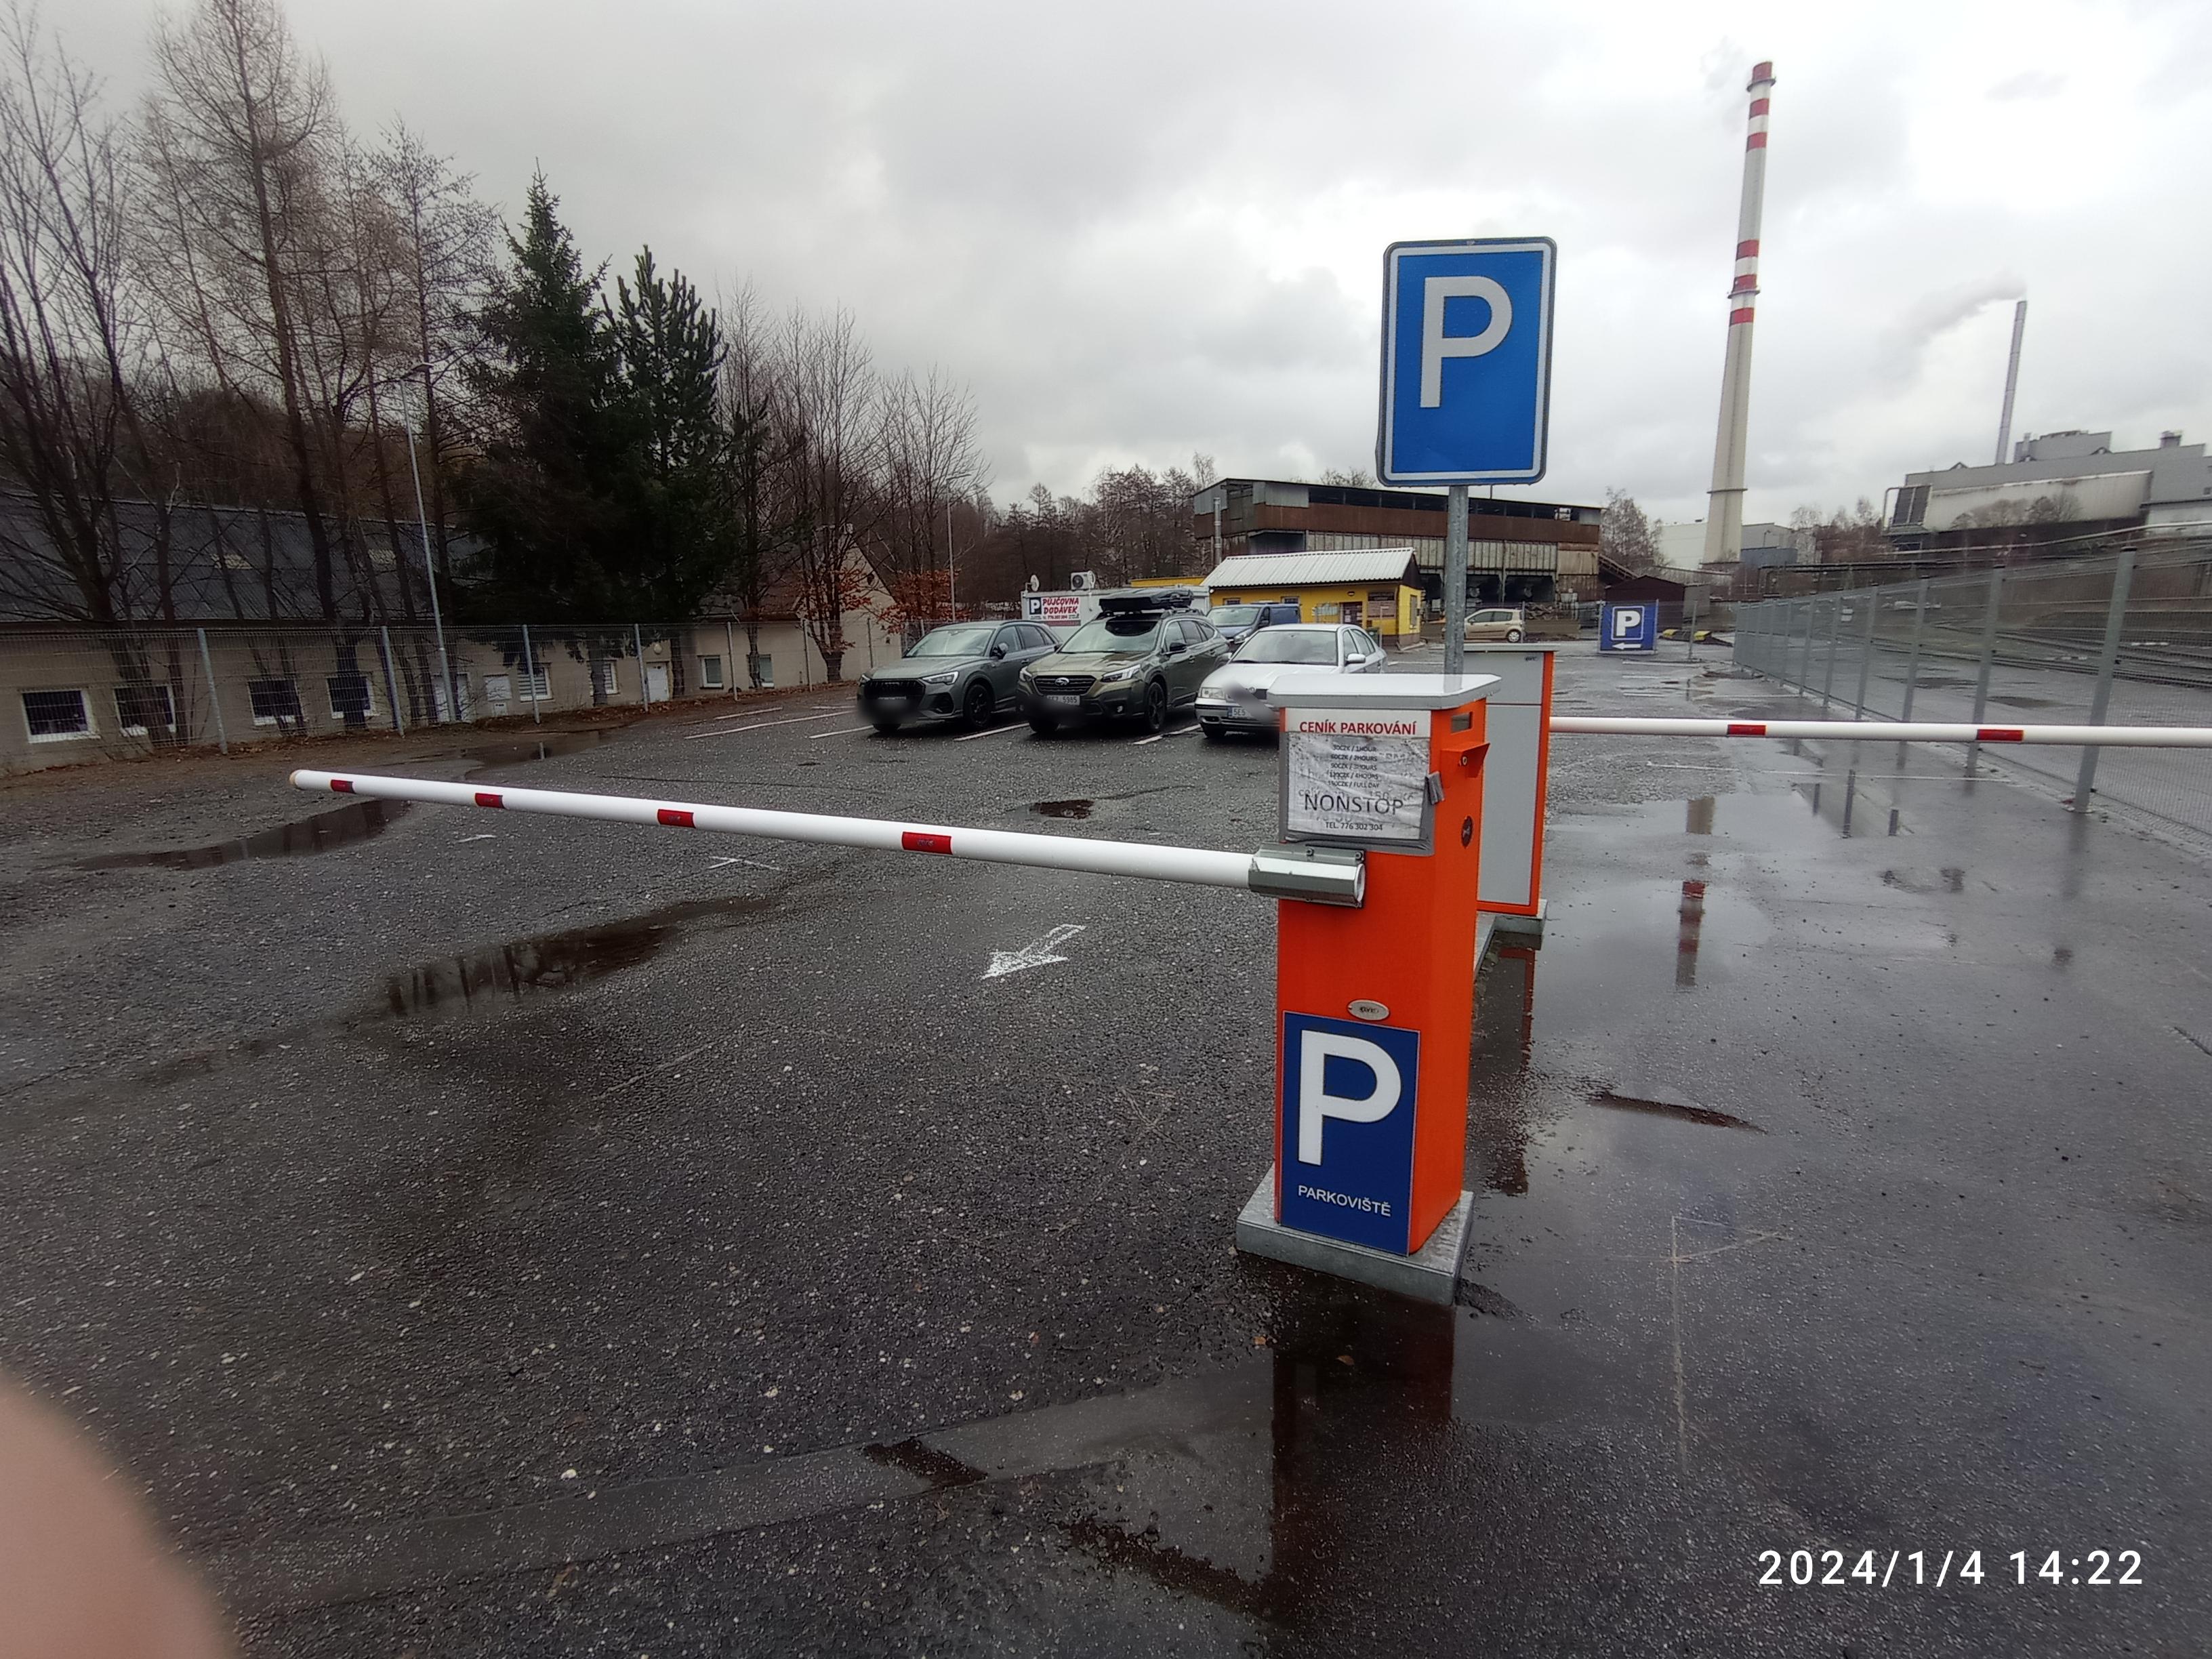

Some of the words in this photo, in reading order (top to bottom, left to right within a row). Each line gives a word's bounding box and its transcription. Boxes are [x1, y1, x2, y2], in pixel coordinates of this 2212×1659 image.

[1420, 275, 1513, 408] P
[1030, 599, 1040, 613] P
[1044, 605, 1078, 615] DODÁVEK
[1616, 610, 1641, 636] P
[1299, 719, 1336, 733] CENÍK
[1340, 720, 1417, 735] PARKOVÁNÍ
[1305, 794, 1404, 815] NONSTOP
[1298, 1029, 1401, 1166] P
[1298, 1185, 1392, 1217] PARKOVIŠTĚ
